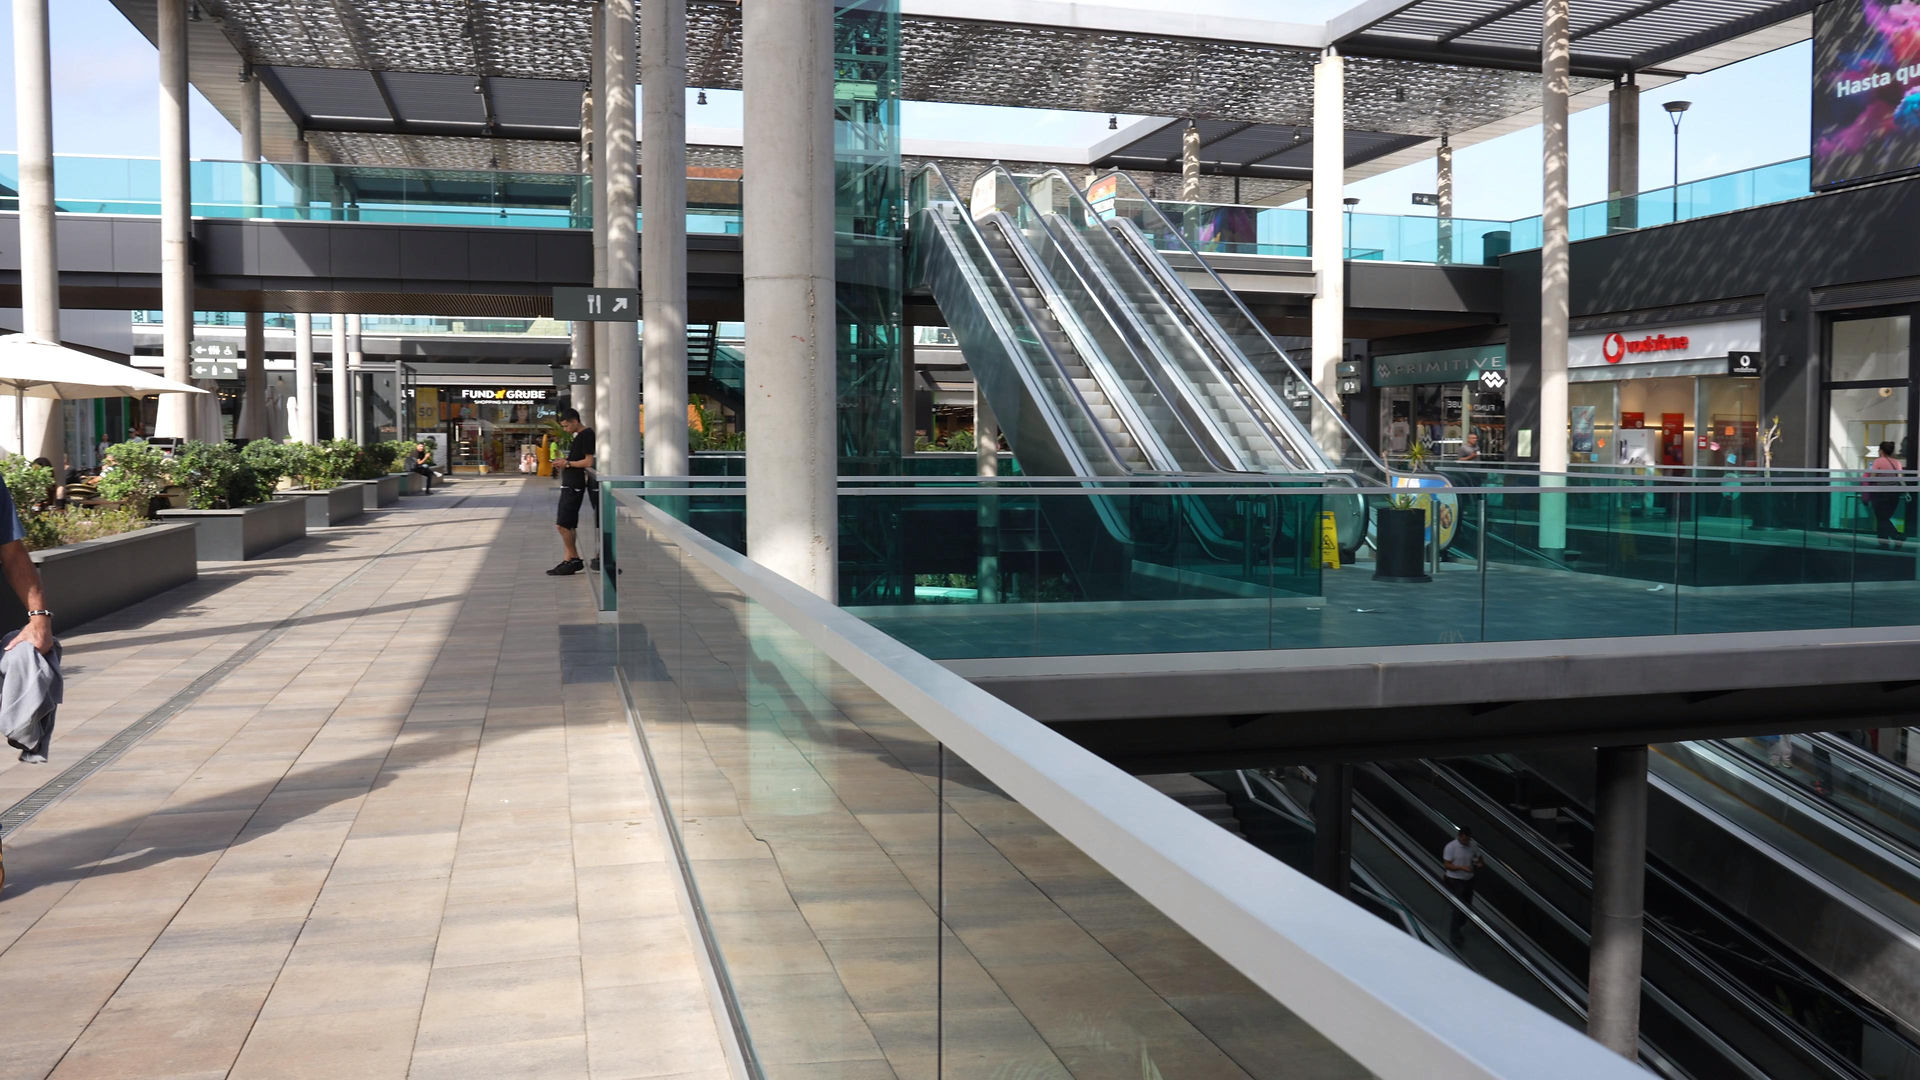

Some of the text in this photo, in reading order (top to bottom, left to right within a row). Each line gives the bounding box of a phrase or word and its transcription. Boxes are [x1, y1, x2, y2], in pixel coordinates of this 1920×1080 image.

[1837, 72, 1891, 98] Hasta
[1627, 334, 1689, 353] vodafone
[1395, 356, 1503, 374] PRIMITIVE
[461, 389, 546, 399] FUND GRUBE
